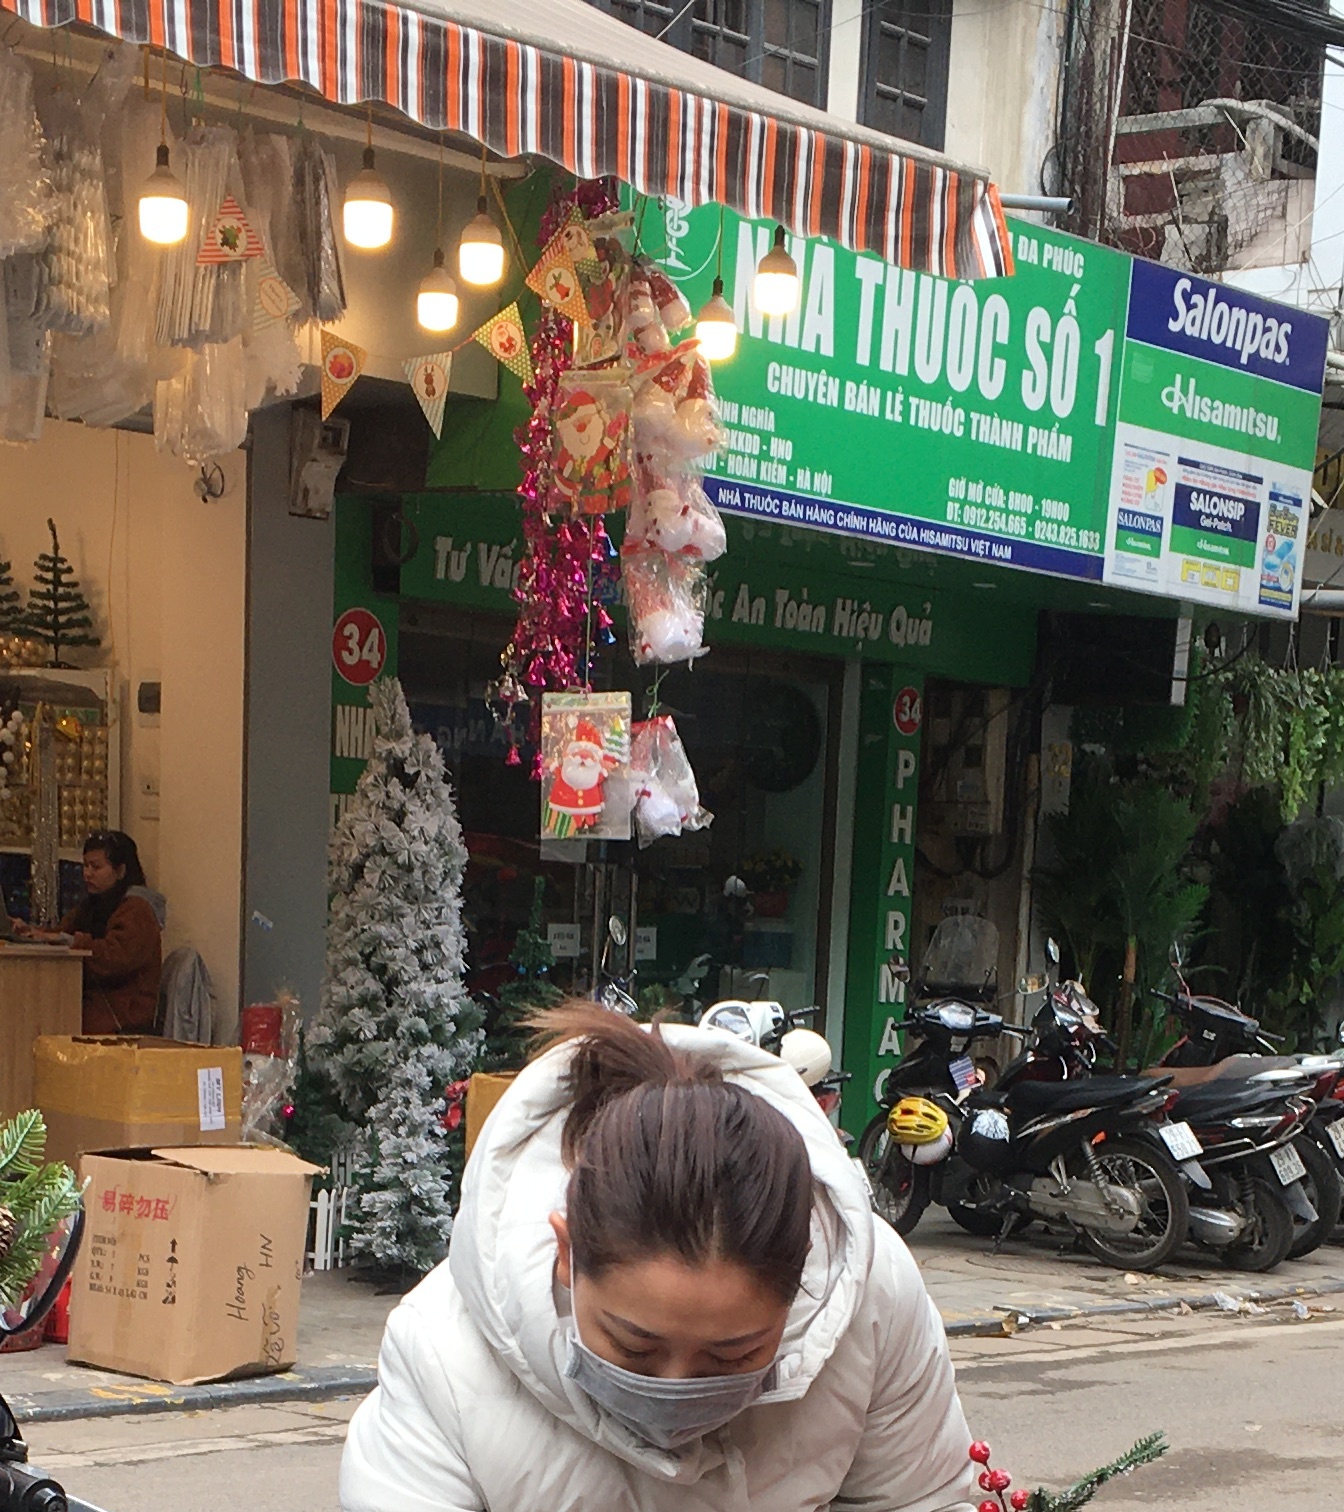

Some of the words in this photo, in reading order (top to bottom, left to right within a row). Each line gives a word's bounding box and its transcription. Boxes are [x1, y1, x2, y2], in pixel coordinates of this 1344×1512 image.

[1017, 234, 1039, 265] ĐA
[1042, 243, 1085, 279] PHÚC
[1167, 277, 1292, 366] Salonpas
[1021, 283, 1081, 419] SỐ
[1094, 328, 1115, 427] 1
[741, 404, 776, 433] NGHĨA
[766, 361, 840, 408] CHUYÊN
[843, 379, 881, 417] BÁN
[884, 385, 905, 423] LẺ
[908, 395, 966, 438] THUỐC
[969, 411, 1024, 452] THÀNH
[1026, 421, 1073, 464] PHẨM
[1160, 373, 1279, 442] Hisamitsu
[727, 452, 758, 480] HOÀN
[759, 456, 788, 486] KIẾM
[796, 465, 811, 492] HÀ
[813, 469, 833, 498] NỘI
[948, 476, 967, 500] GIỜ
[967, 479, 985, 503] MỞ
[1008, 489, 1034, 515] 8H00
[1040, 498, 1070, 523] 19H00
[963, 504, 1027, 537] 0912.254.665
[1117, 511, 1162, 533] SALONPAS
[1189, 491, 1245, 521] SALONSIP
[718, 487, 741, 508] NHÀ
[743, 491, 780, 515] THUỐC
[782, 500, 805, 520] BÁN
[805, 503, 835, 526] HÀNG
[836, 508, 868, 532] CHÍNH
[868, 516, 897, 538] HÃNG
[898, 519, 919, 542] CỦA
[919, 527, 969, 552] HISAMITSU
[970, 536, 991, 558] VIỆT
[991, 543, 1012, 561] NAM
[435, 535, 471, 582] Tư
[731, 582, 767, 626] An
[774, 586, 826, 634] Toàn
[832, 597, 884, 652] Hiệu
[888, 600, 933, 648] Quả
[341, 622, 382, 669] 34
[896, 695, 922, 724] 34
